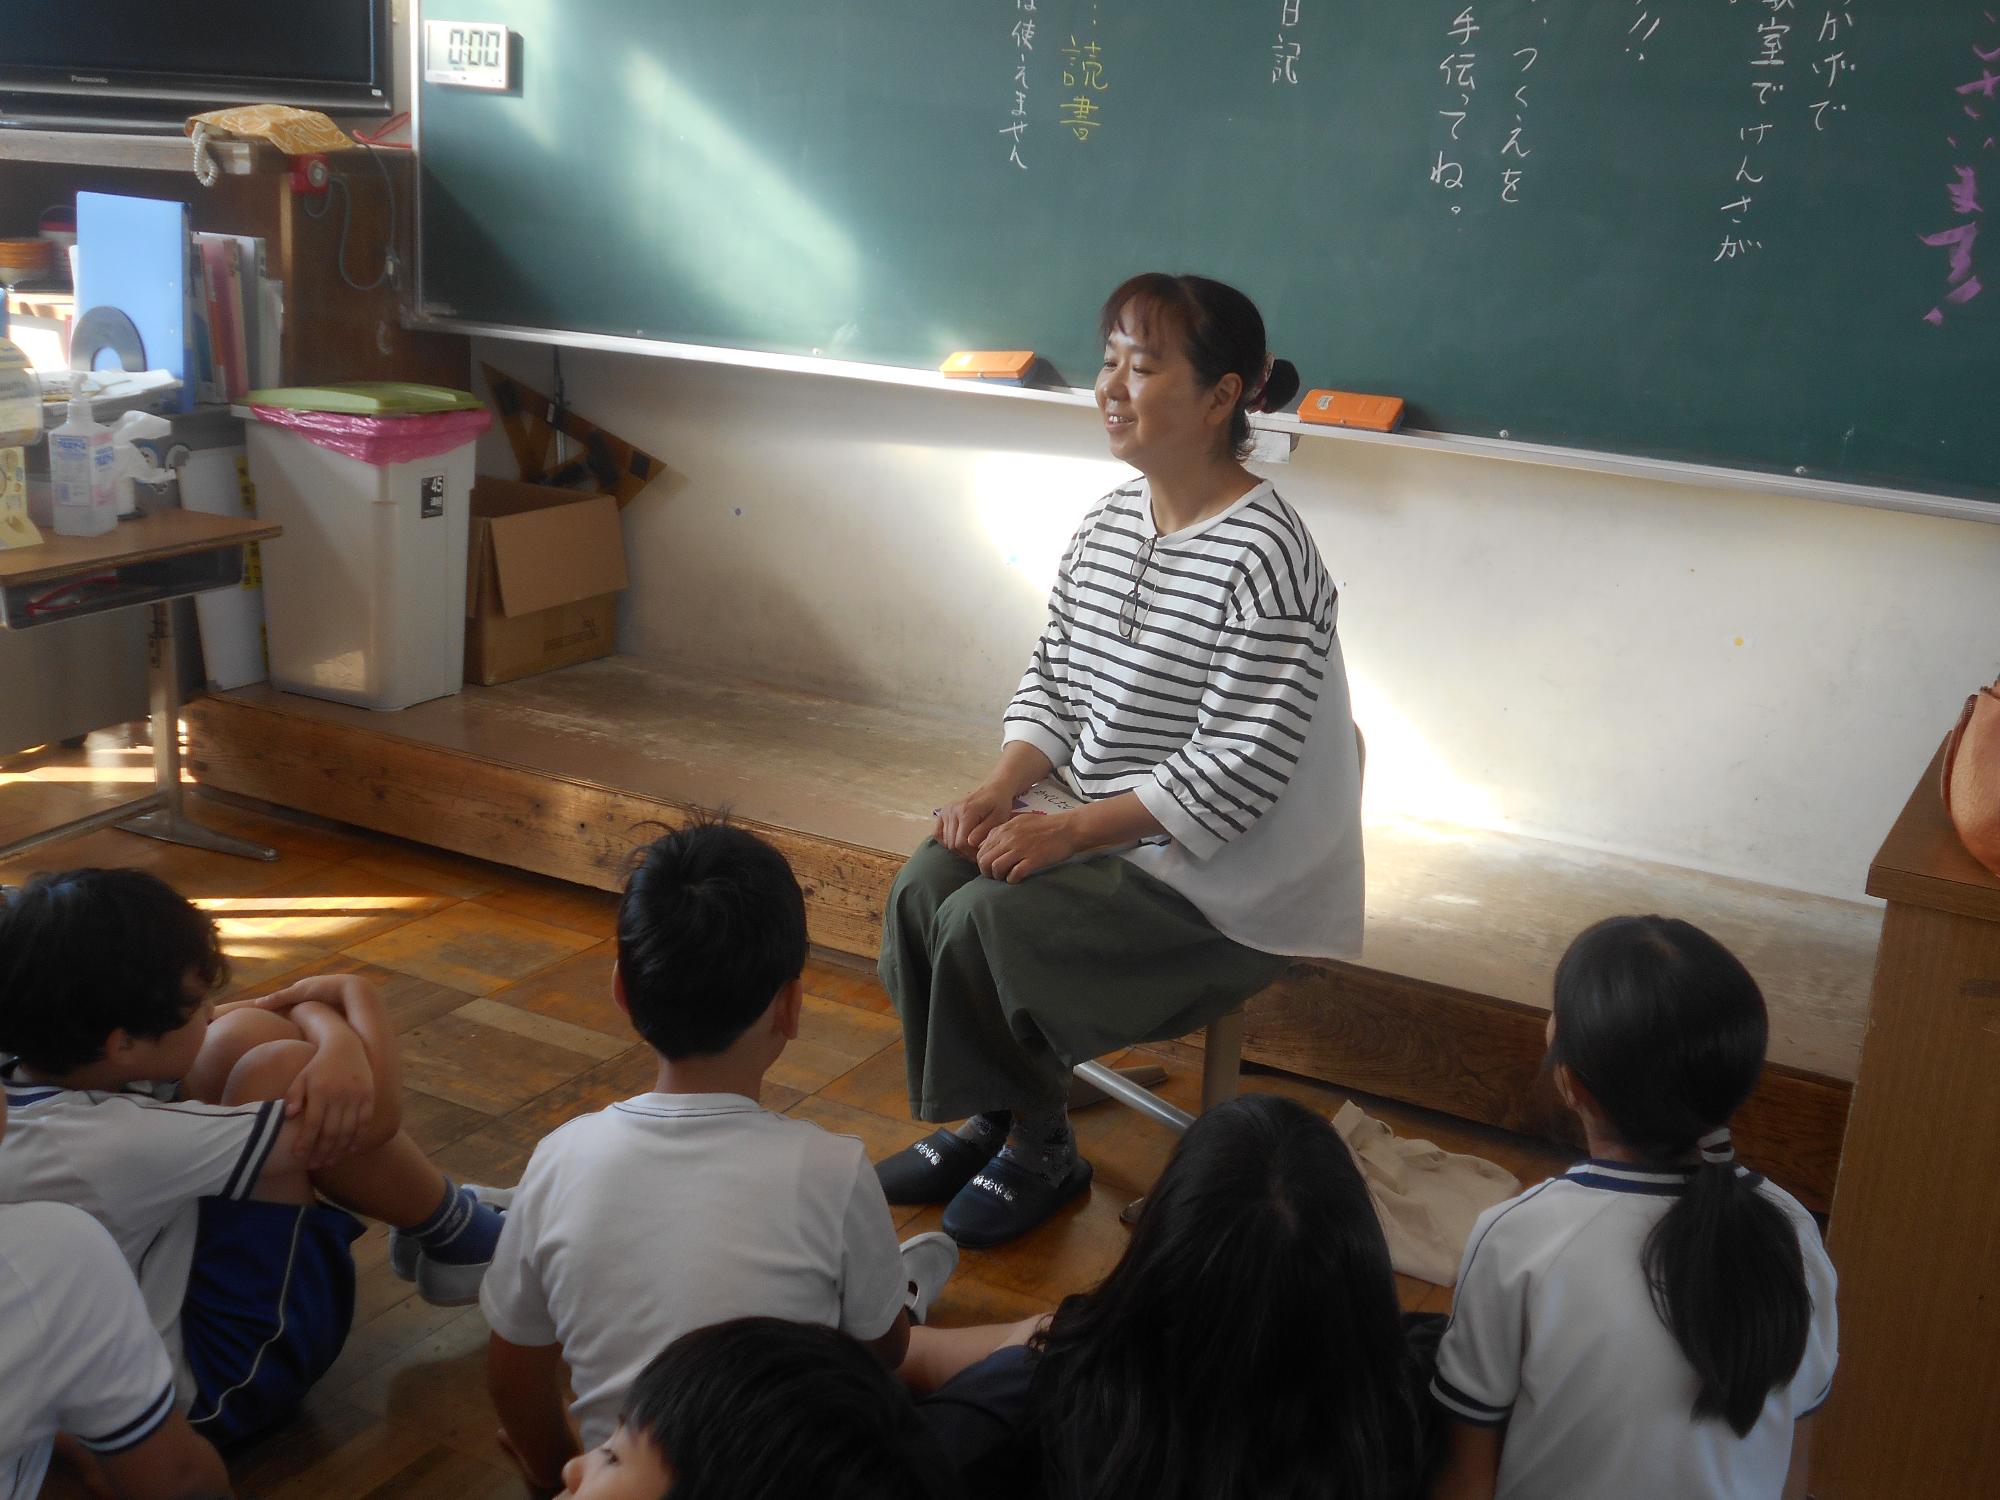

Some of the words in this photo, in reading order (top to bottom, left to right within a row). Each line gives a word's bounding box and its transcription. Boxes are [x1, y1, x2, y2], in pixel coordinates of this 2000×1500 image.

[448, 28, 501, 67] 0:00
[1271, 0, 1300, 84] 日記
[1713, 0, 1794, 262] 室でけんさが
[431, 476, 443, 493] 45
